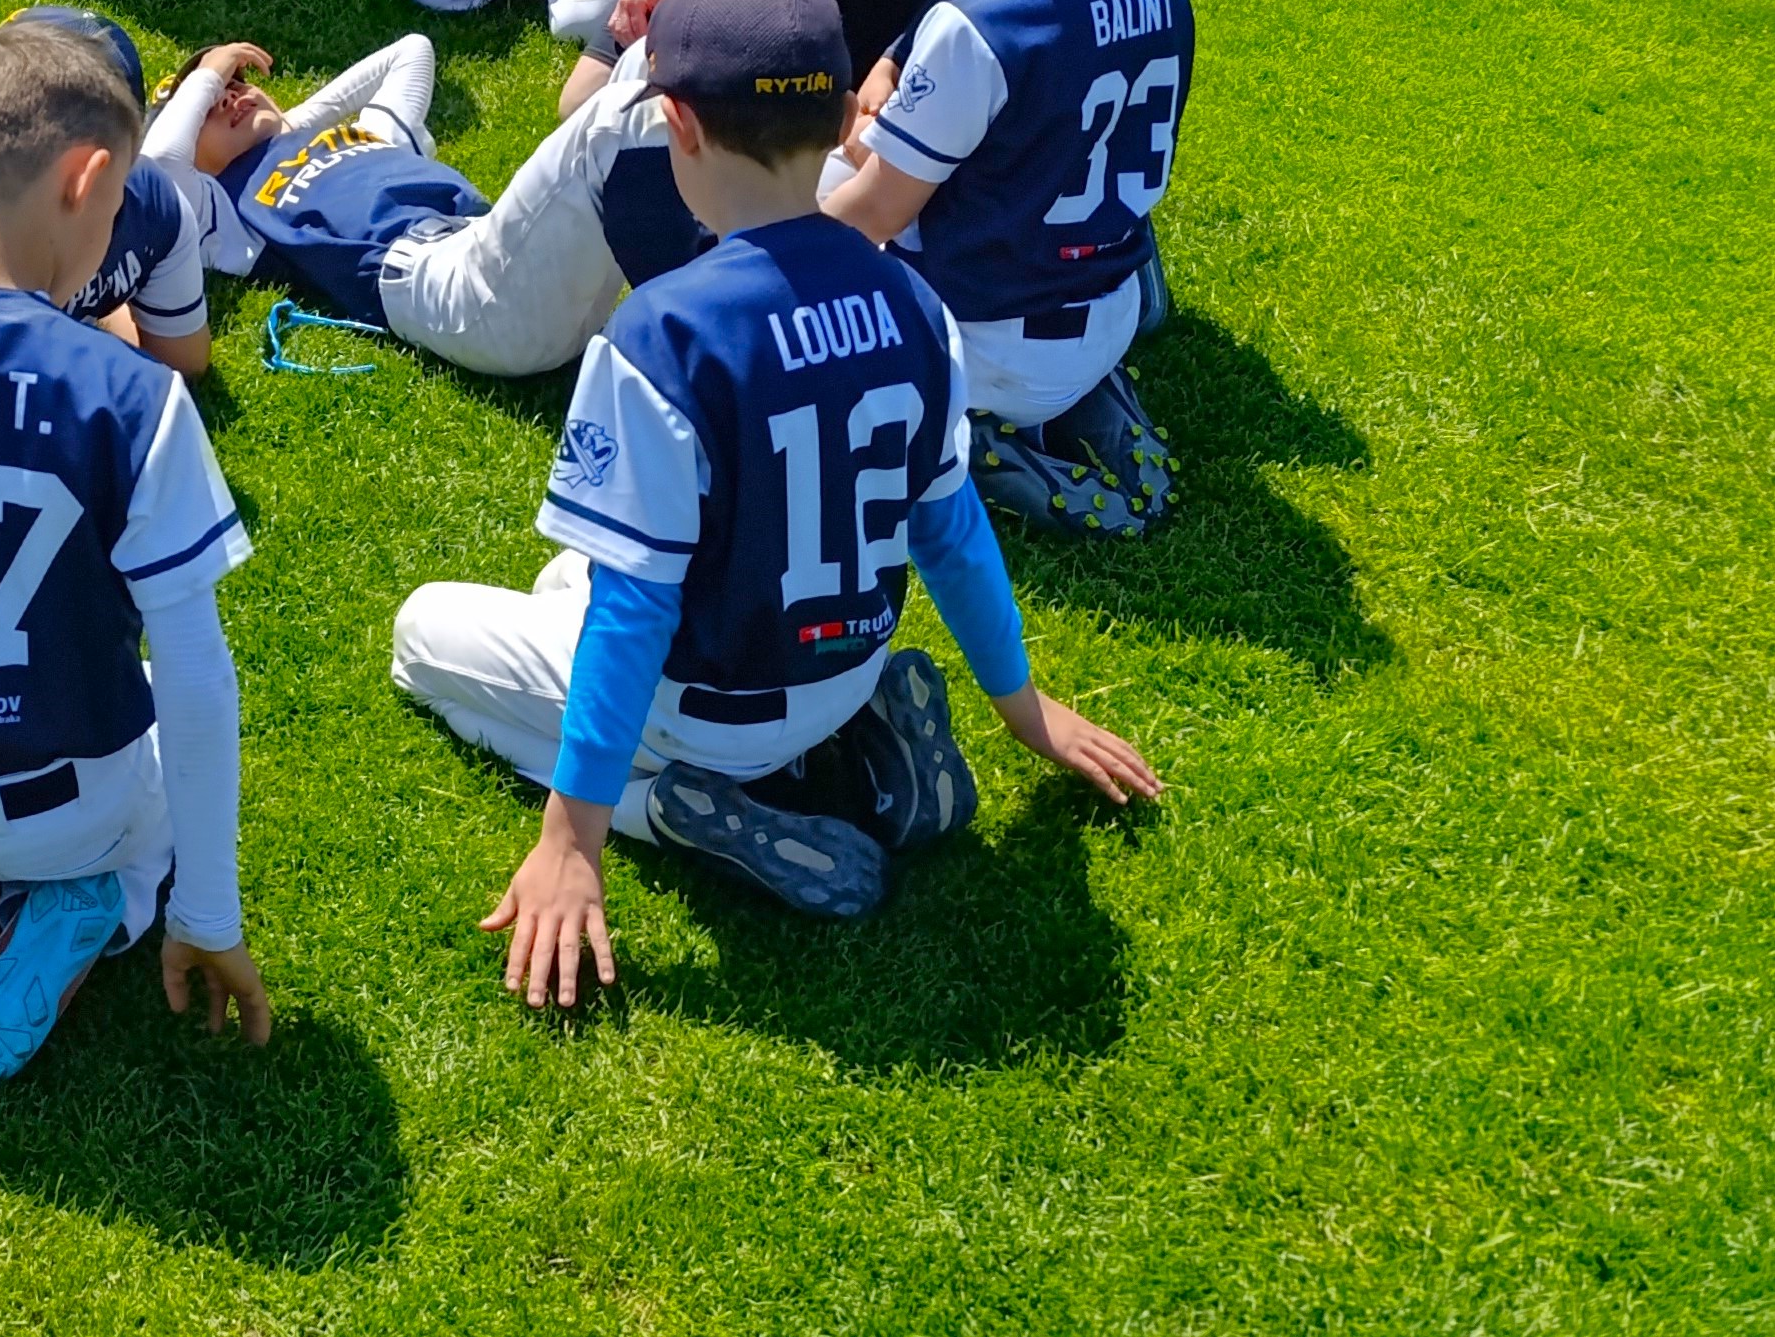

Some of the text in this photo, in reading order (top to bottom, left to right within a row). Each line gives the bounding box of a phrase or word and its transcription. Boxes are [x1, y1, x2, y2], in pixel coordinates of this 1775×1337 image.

[1043, 54, 1180, 225] 33
[768, 290, 903, 372] LOUDA
[9, 370, 53, 435] T.
[767, 381, 925, 612] 12
